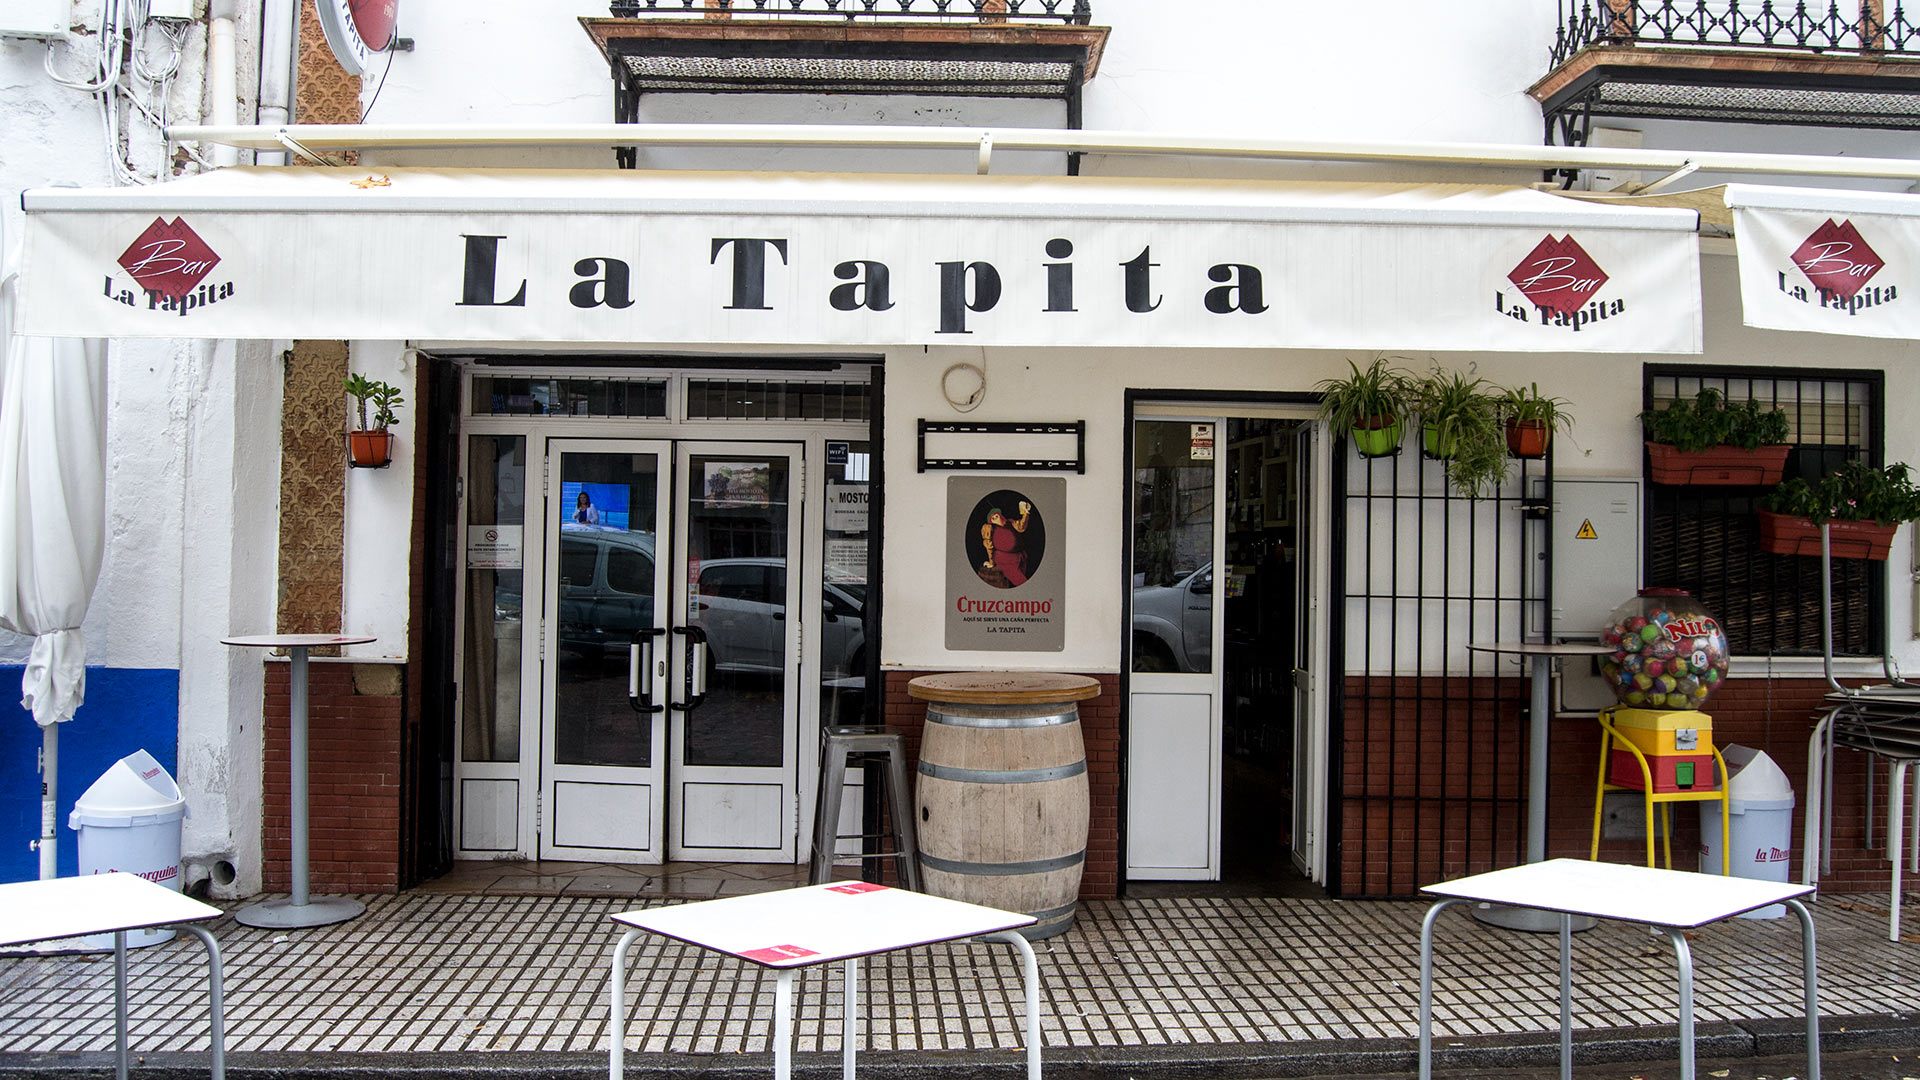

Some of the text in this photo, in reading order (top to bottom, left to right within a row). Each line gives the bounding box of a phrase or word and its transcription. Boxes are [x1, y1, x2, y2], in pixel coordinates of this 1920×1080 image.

[117, 239, 212, 278] Bar
[1507, 256, 1601, 294] Bar
[1789, 241, 1877, 277] Bar
[104, 275, 235, 317] La Tapita
[455, 234, 1270, 334] La Tapita
[1778, 270, 1898, 316] La Tapita
[1495, 289, 1625, 332] La Tapita
[1468, 360, 1478, 375] 2
[839, 492, 869, 504] MOSTO
[957, 594, 1052, 616] Cruzcampo
[1664, 618, 1721, 642] NILO
[1754, 848, 1767, 860] la
